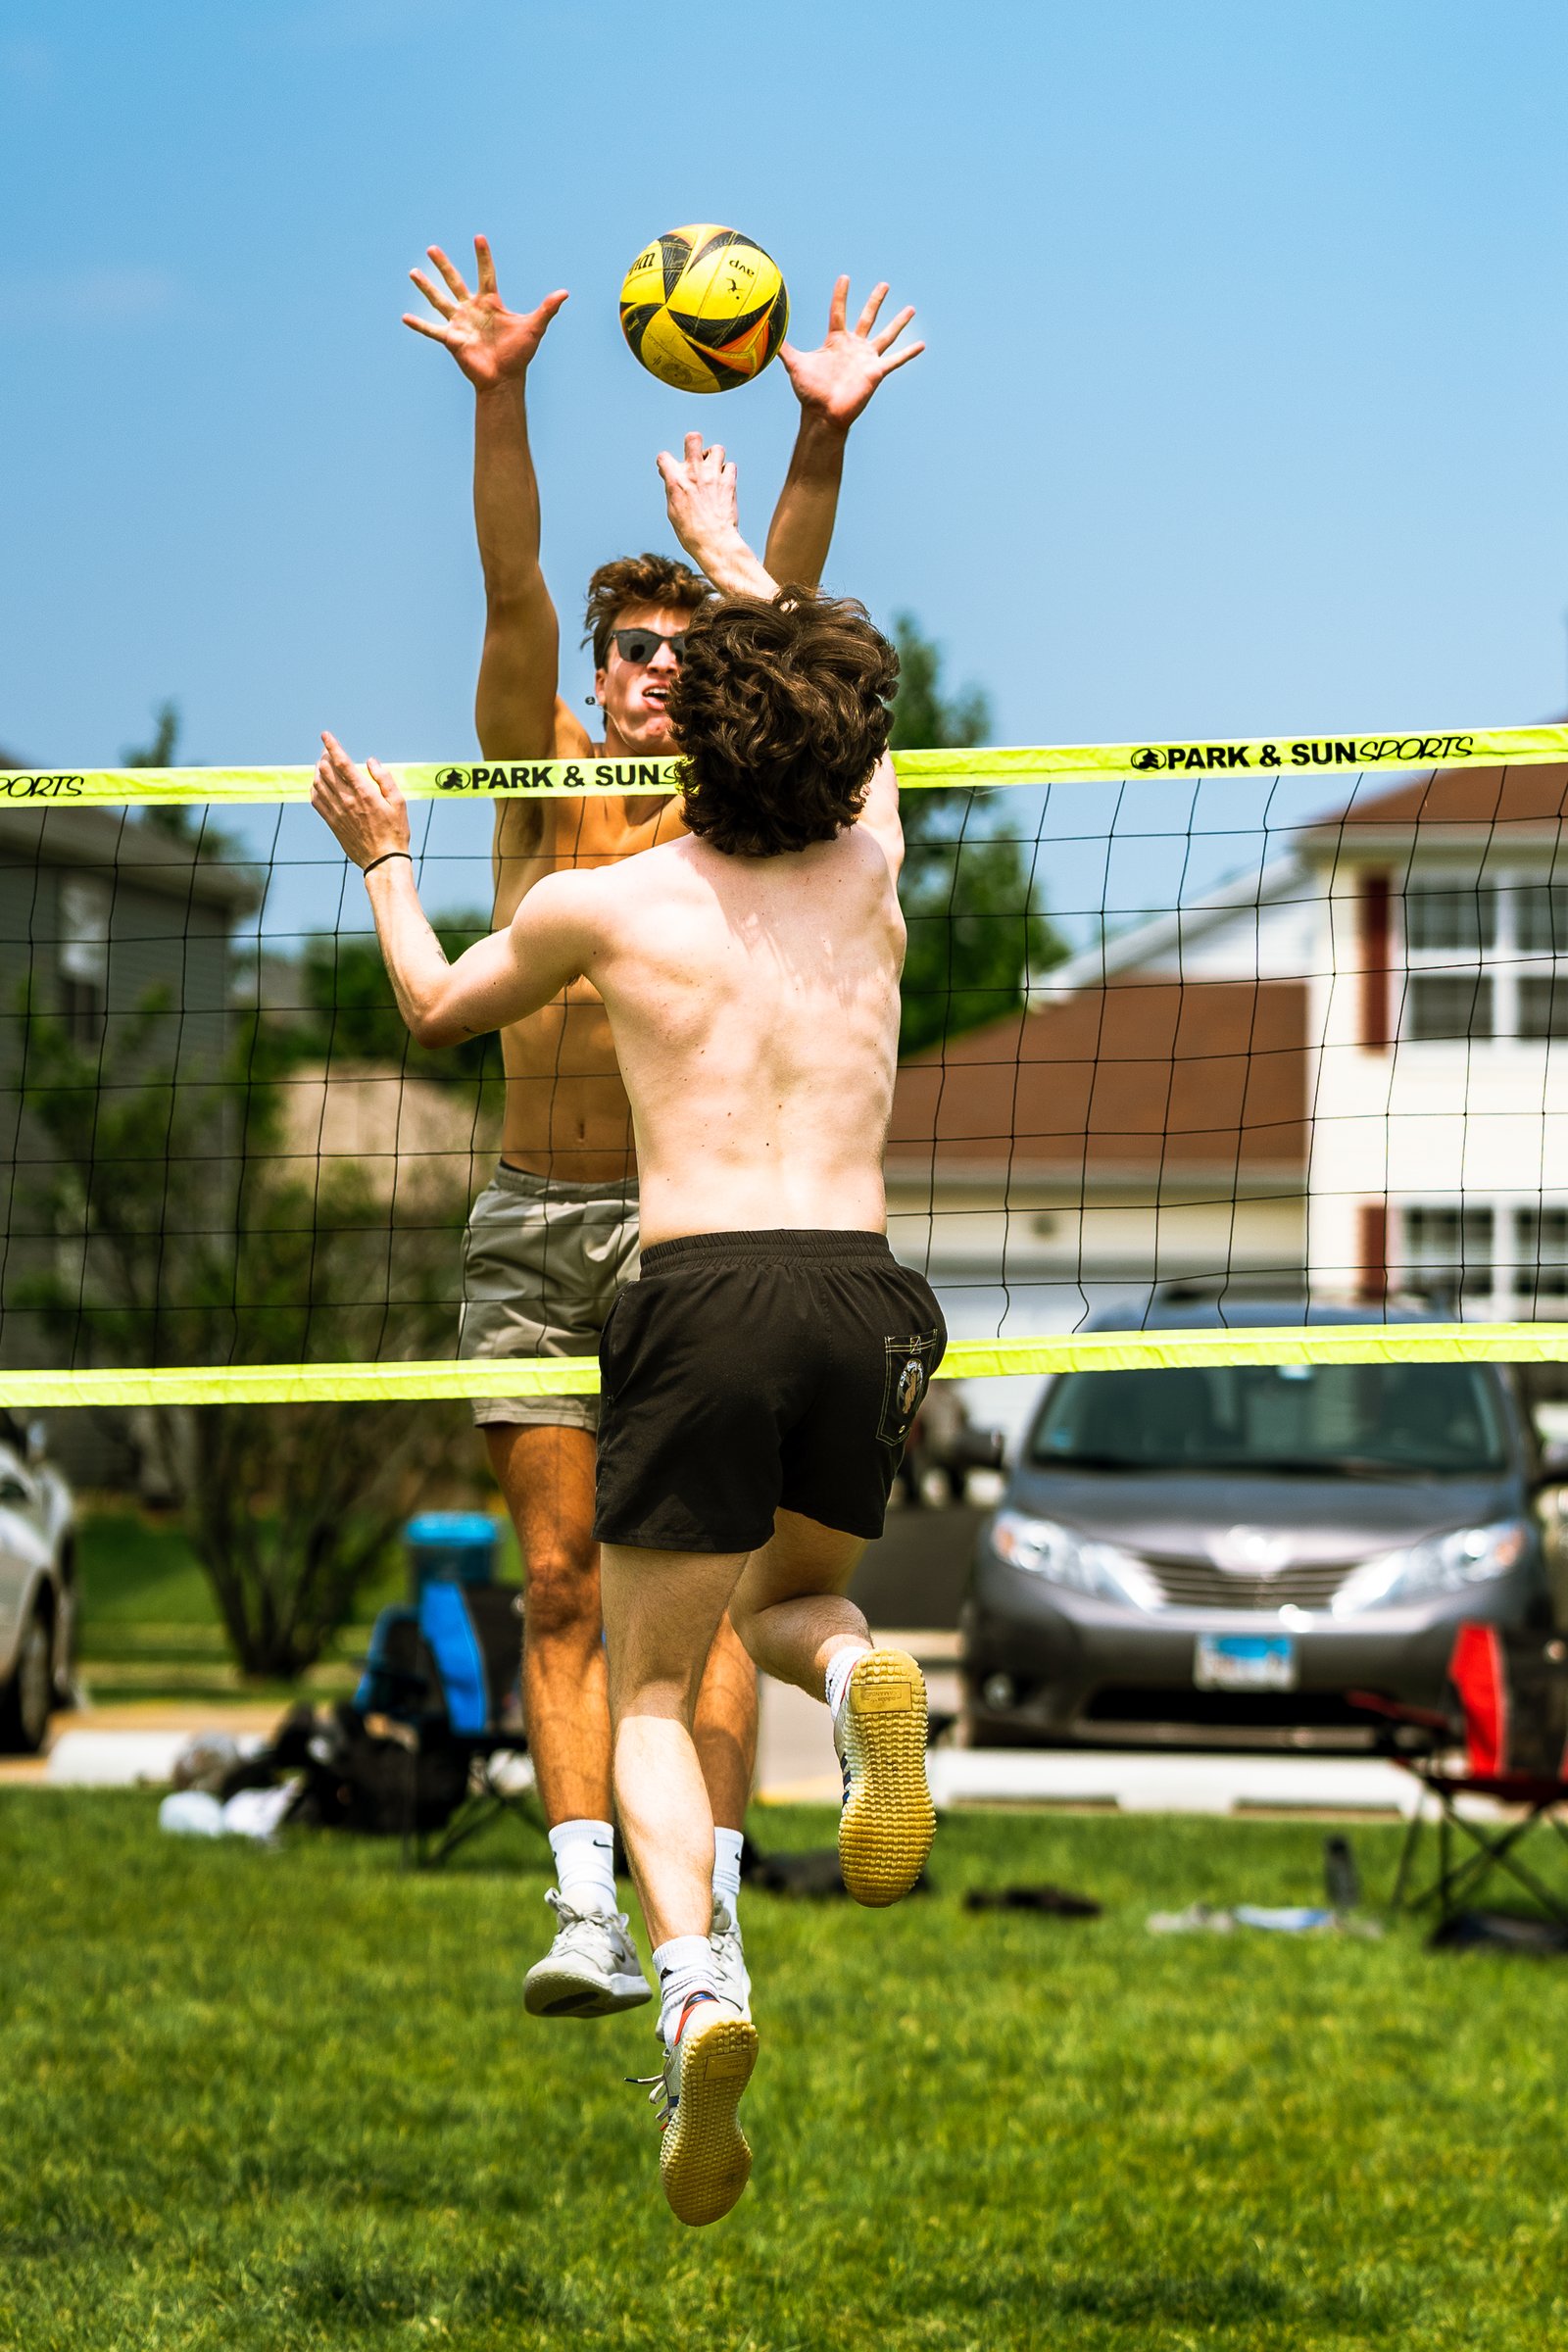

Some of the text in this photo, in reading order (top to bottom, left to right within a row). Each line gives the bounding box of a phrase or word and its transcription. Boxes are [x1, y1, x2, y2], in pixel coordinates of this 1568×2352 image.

[1167, 746, 1250, 769] PARK
[1258, 745, 1283, 767] &
[471, 766, 554, 789] PARK
[563, 765, 585, 787] &
